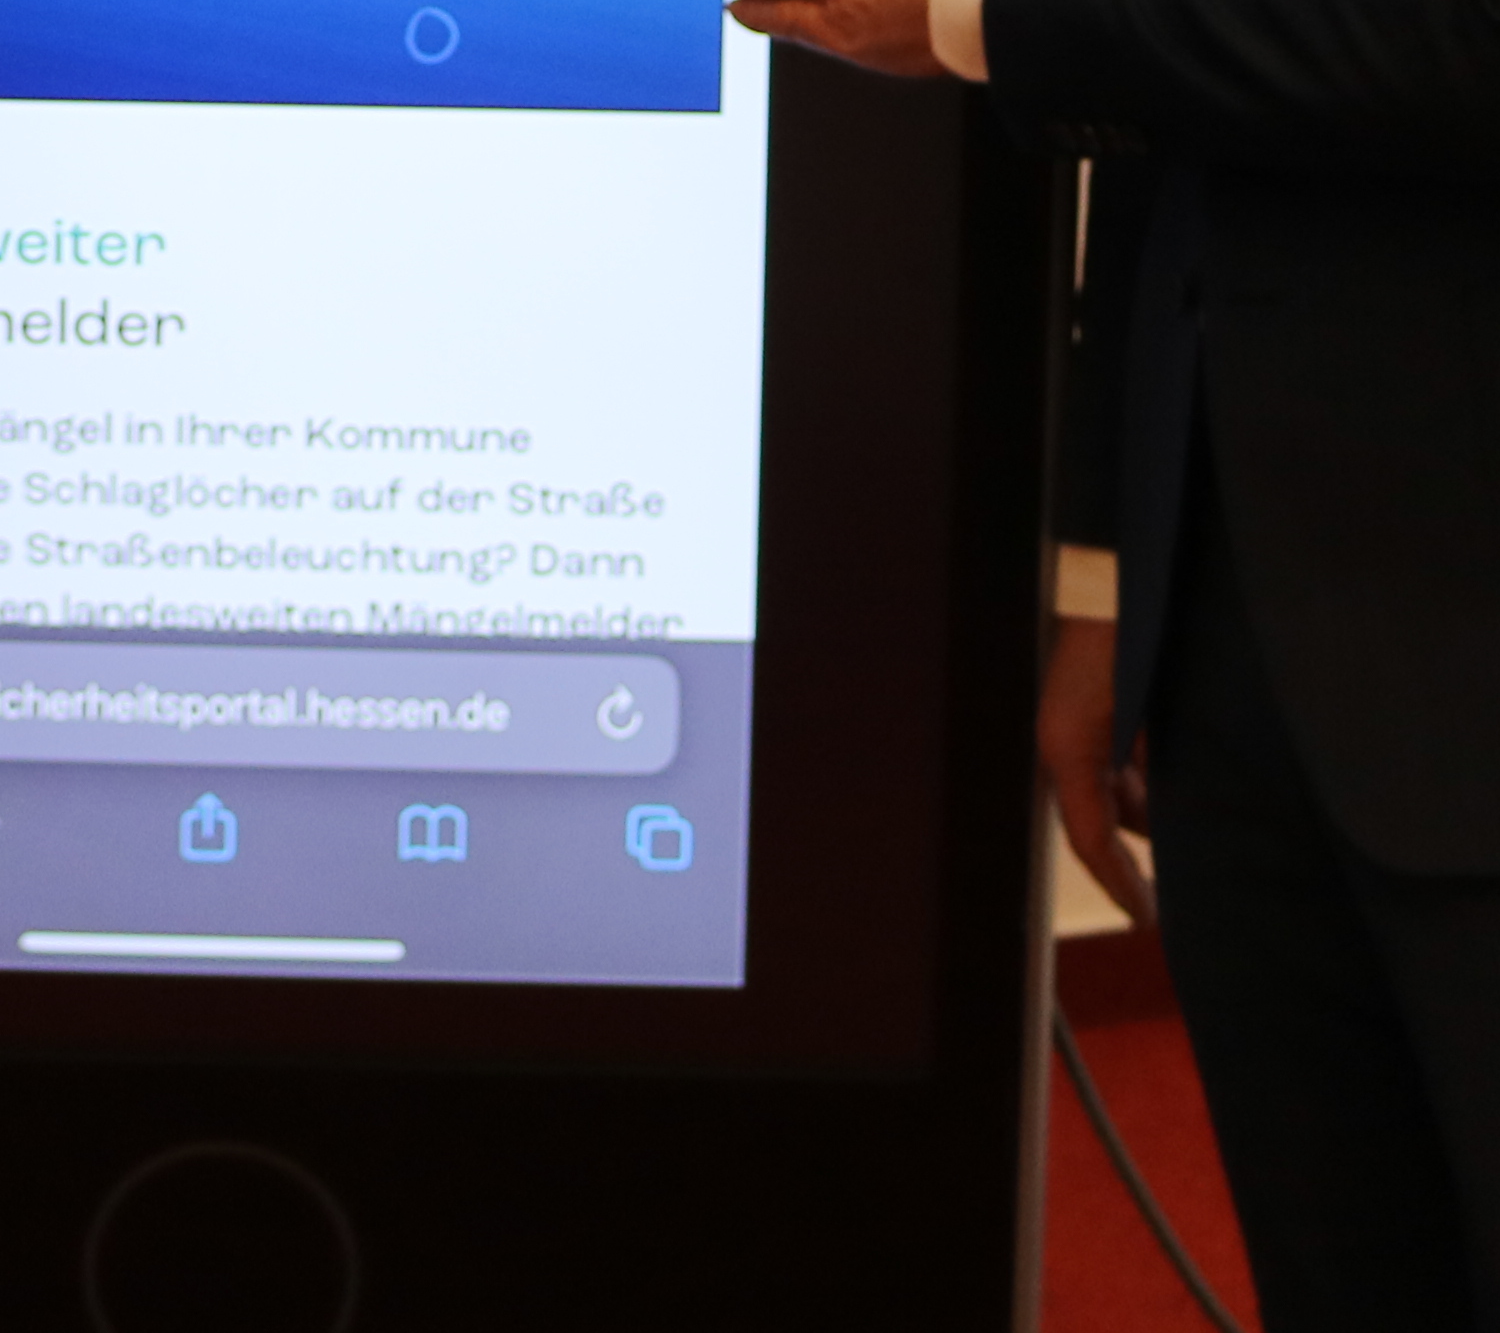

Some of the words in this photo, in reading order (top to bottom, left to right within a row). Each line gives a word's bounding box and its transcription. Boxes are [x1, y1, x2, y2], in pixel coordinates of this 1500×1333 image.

[122, 412, 166, 447] in
[174, 412, 293, 451] Ihrer
[303, 416, 533, 456] Kommune
[20, 469, 320, 518] Schlaglöcher
[329, 475, 404, 514] auf
[415, 478, 497, 516] der
[506, 480, 667, 520] Straße
[22, 530, 518, 587] Straßenbeleuchtung?
[528, 541, 646, 579] Dann
[62, 593, 354, 632] landesweiten
[368, 600, 687, 640] Mängelmelder
